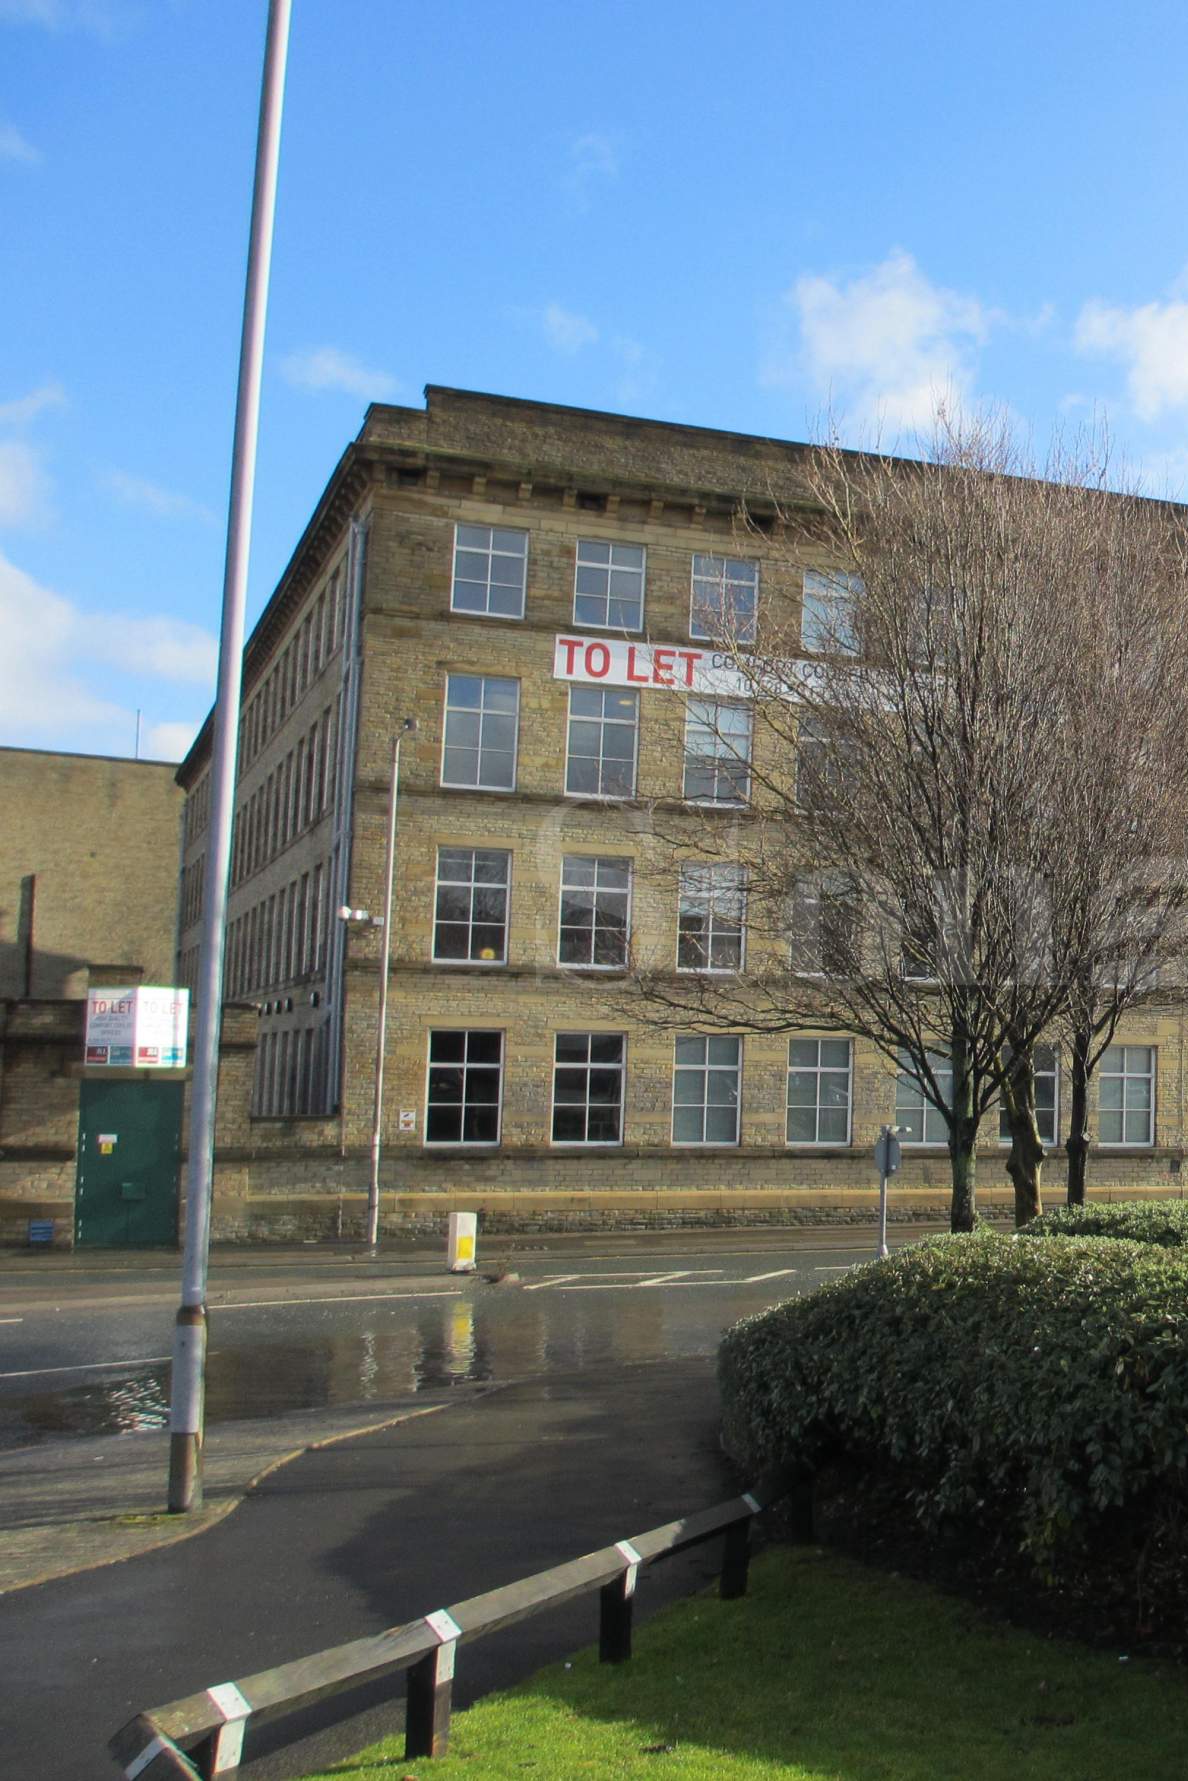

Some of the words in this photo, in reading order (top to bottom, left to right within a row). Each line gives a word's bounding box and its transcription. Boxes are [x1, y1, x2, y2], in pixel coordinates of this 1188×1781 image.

[559, 639, 611, 678] TO
[627, 646, 703, 688] LET
[92, 1000, 107, 1014] TO
[111, 1000, 133, 1014] LET
